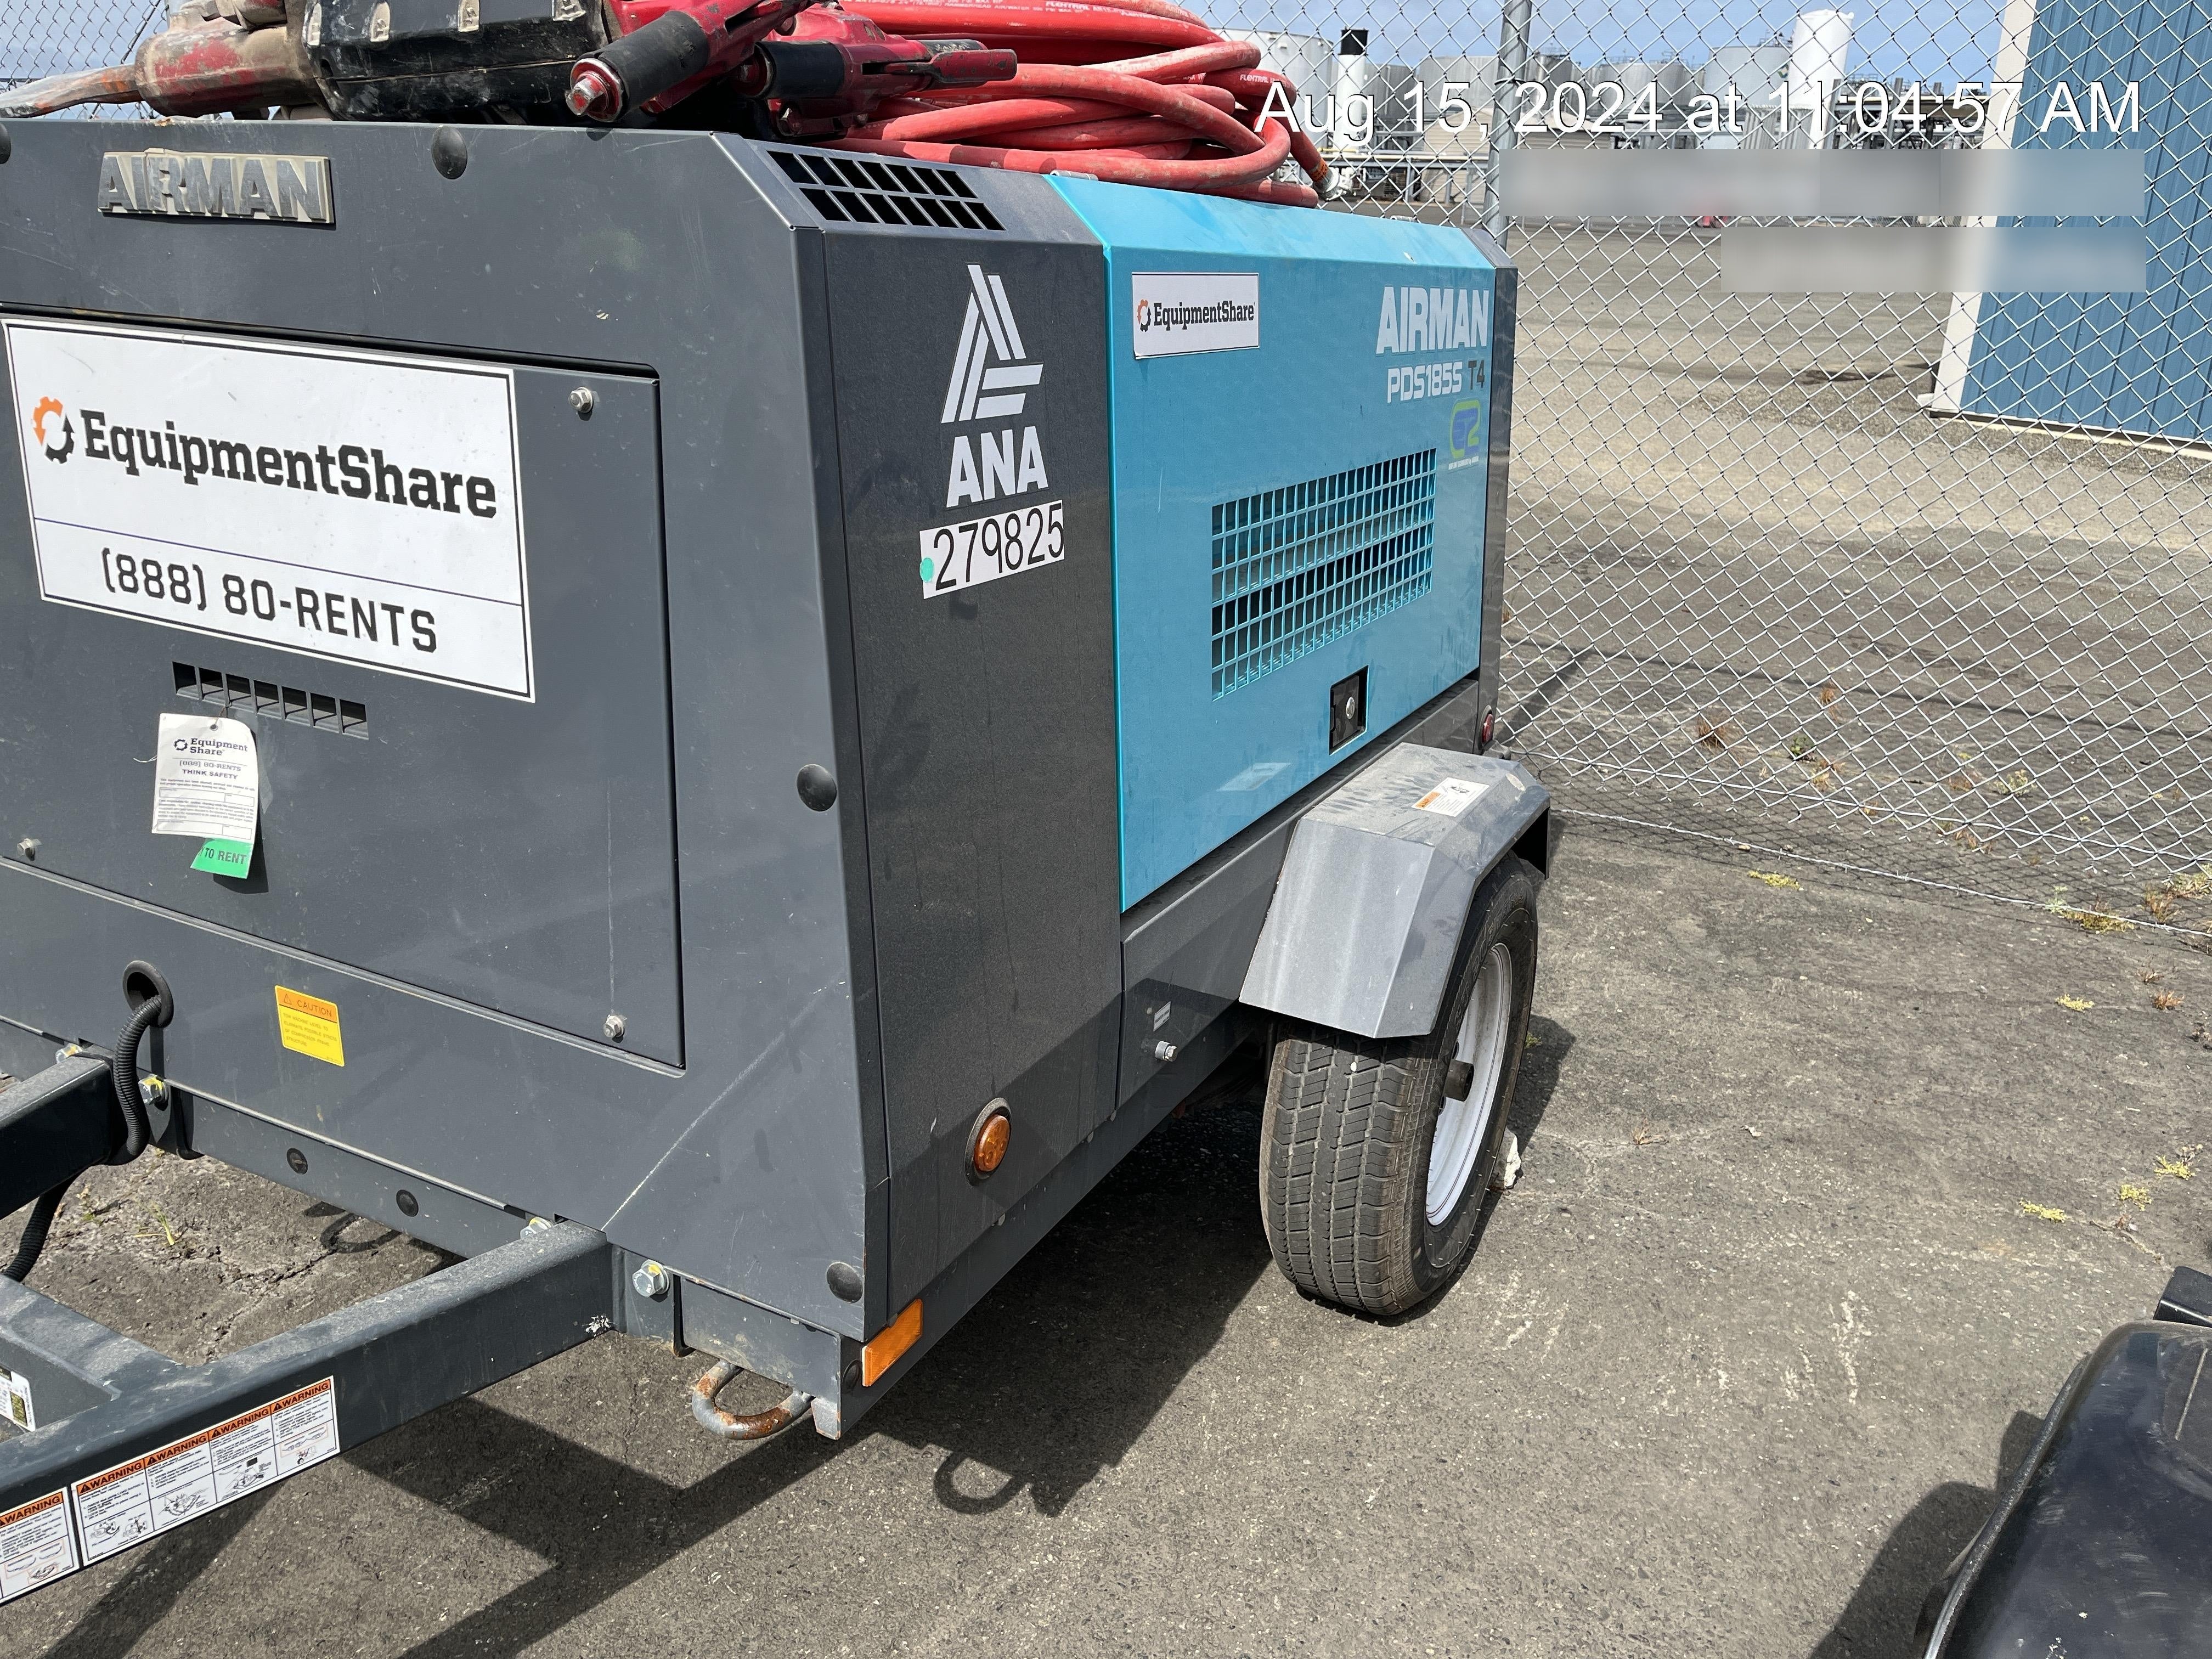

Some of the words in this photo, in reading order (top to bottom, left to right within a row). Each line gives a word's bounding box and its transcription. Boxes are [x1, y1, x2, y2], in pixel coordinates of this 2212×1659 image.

[1239, 74, 1268, 83] FLEXTRAL
[98, 155, 328, 223] AIRMAN
[1153, 300, 1255, 331] EquipmentShare
[1376, 286, 1489, 354] AIRMAN
[1468, 360, 1486, 390] T4
[80, 409, 496, 518] EquipmentShare
[946, 426, 1048, 508] ANA
[933, 501, 1064, 591] 279825
[102, 548, 207, 611] (888)
[222, 574, 438, 653] 80-RENTS
[190, 738, 248, 752] Equipment
[190, 747, 223, 755] Share
[204, 762, 241, 771] 80-RENTS
[209, 771, 238, 780] SAFETY
[205, 848, 215, 859] TO
[217, 850, 247, 864] RENT
[297, 1000, 332, 1017] CAUTION
[282, 1383, 329, 1407] WARNING
[219, 1408, 269, 1434] WARNING
[156, 1435, 206, 1461] WARNING
[90, 1462, 142, 1489] WARNING
[5, 1496, 60, 1523] WARNING
